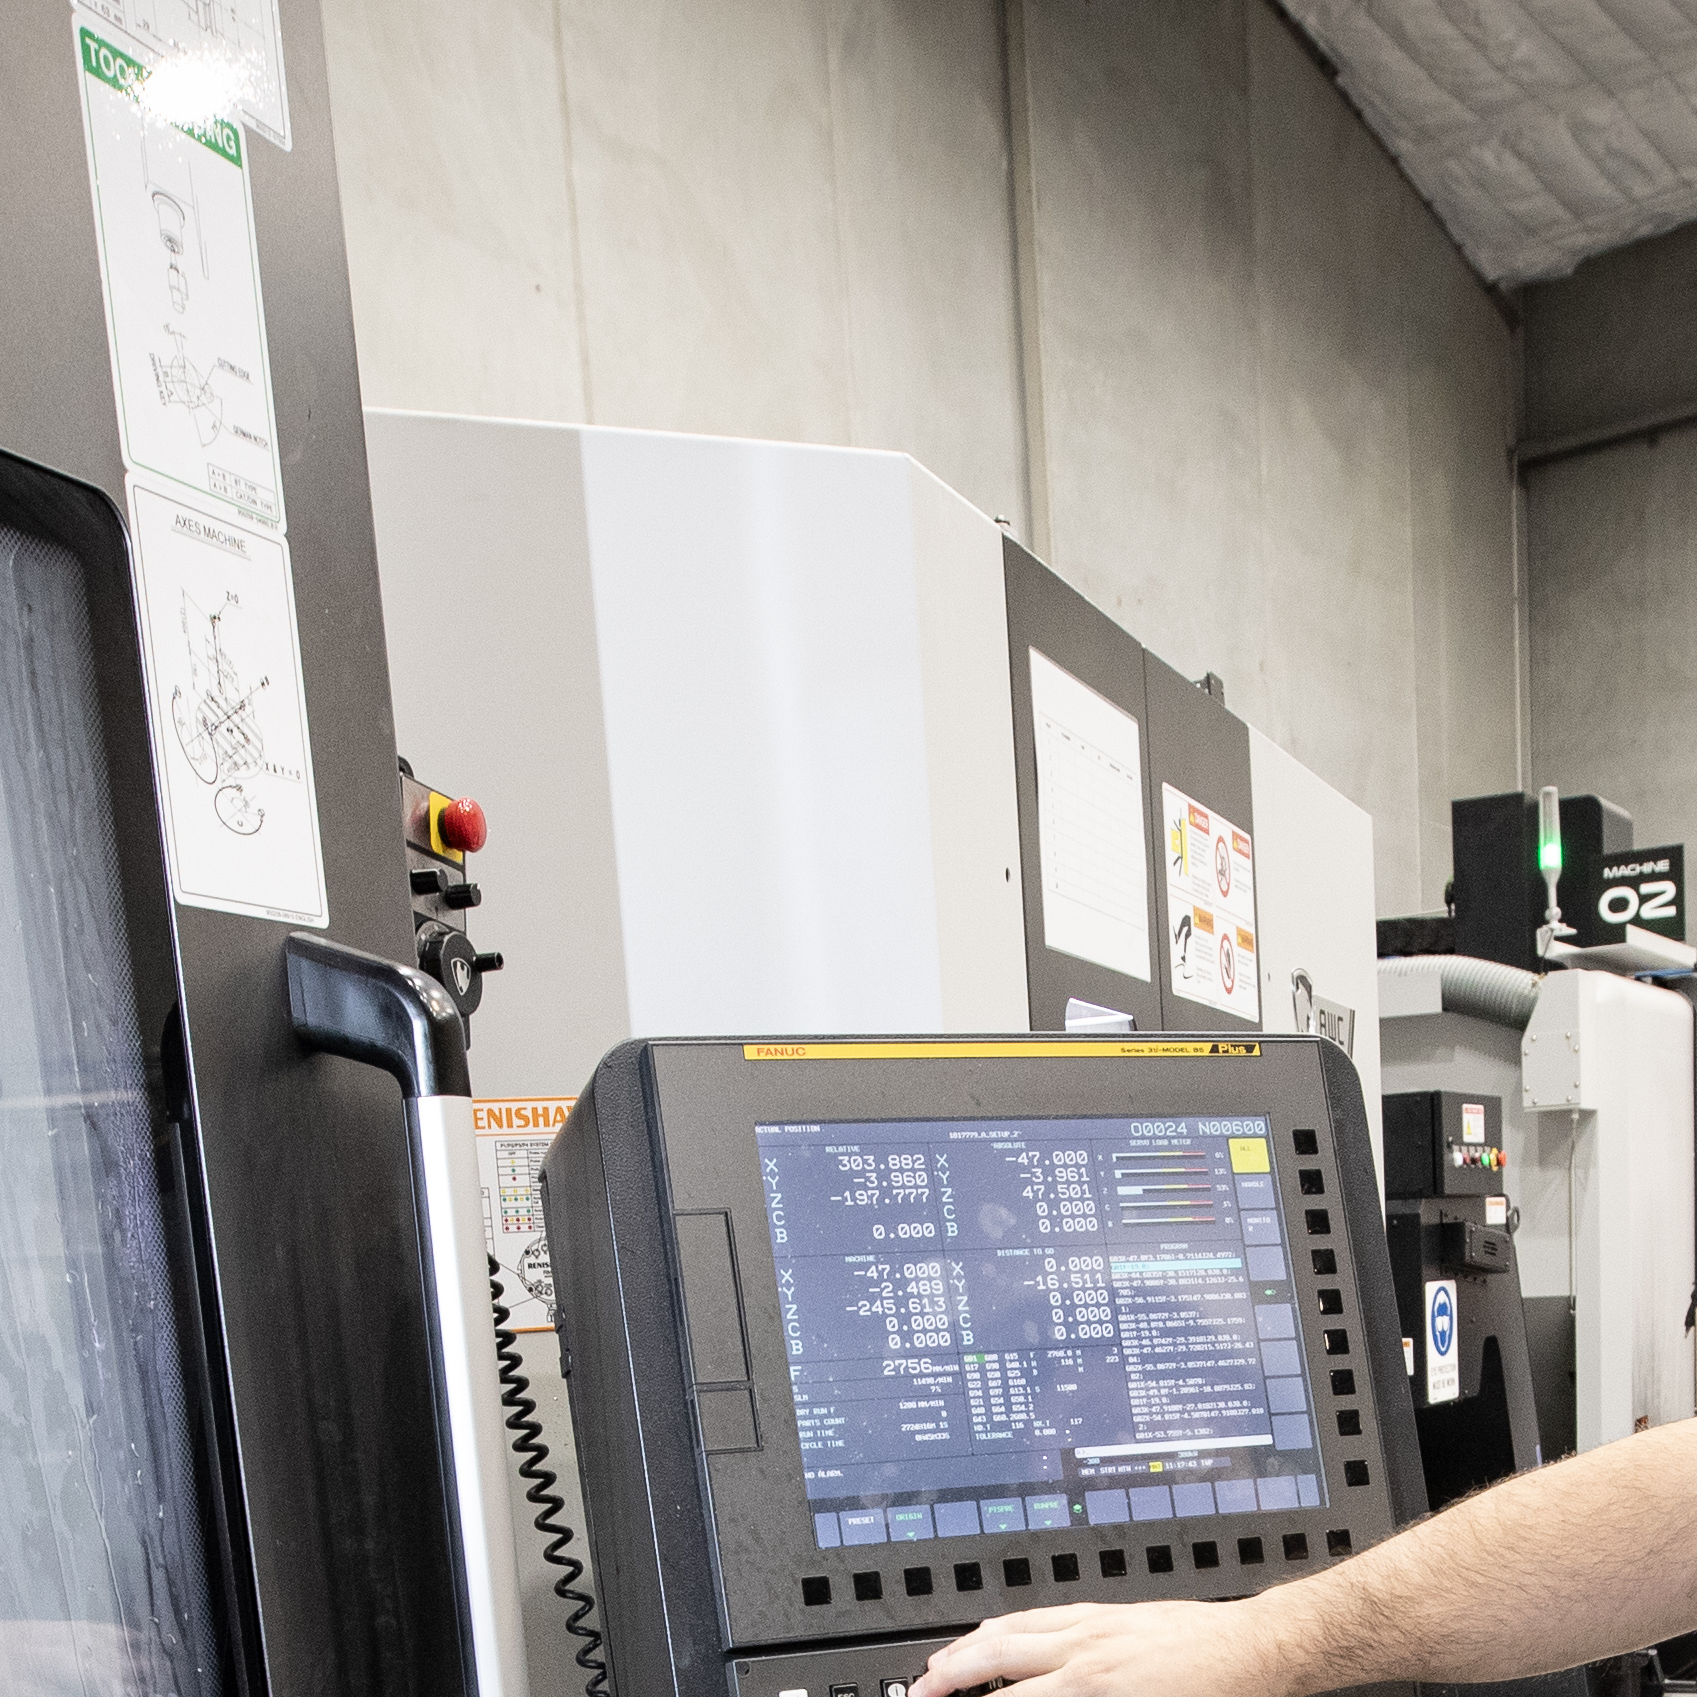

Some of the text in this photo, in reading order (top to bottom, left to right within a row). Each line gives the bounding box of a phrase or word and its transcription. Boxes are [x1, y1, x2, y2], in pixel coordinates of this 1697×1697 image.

[175, 514, 246, 553] AXES MACHINE
[1603, 859, 1670, 879] MACHINE
[1598, 880, 1676, 924] 02
[756, 1047, 806, 1057] FANUC
[1218, 1043, 1247, 1055] Plus
[472, 1106, 574, 1130] ENISHA
[785, 1125, 820, 1133] POSITION
[1198, 1120, 1266, 1135] N00600
[825, 1145, 860, 1153] RELATIVE
[765, 1155, 925, 1172] X 303.882
[936, 1151, 1088, 1168] X -47.000
[767, 1172, 927, 1190] Y -3.960
[938, 1168, 1090, 1185] Y -3.961
[769, 1189, 929, 1208] Z -197.777
[941, 1185, 1092, 1202] Z 47.501
[773, 1211, 785, 1225] C
[943, 1201, 1095, 1219] C 0.000
[775, 1223, 935, 1243] B 0.000
[946, 1218, 1098, 1237] B 0.000
[997, 1248, 1030, 1256] DISTANCE
[1160, 1242, 1188, 1250] PROGRAM
[845, 1255, 876, 1263] MACHINE
[951, 1256, 1103, 1276] X 0.000
[780, 1263, 940, 1283] X -47.000
[783, 1280, 943, 1301] Y -2.489
[954, 1273, 1105, 1293] Y -16.511
[785, 1297, 946, 1319] Z -245.613
[956, 1290, 1108, 1310] Z 0.000
[788, 1314, 948, 1337] C 0.000
[959, 1307, 1111, 1327] C 0.000
[962, 1324, 1113, 1345] B 0.000
[790, 1332, 950, 1355] B 0.000
[790, 1366, 801, 1381] F
[797, 1408, 810, 1416] DRY
[797, 1417, 845, 1427] PARTS COUNT
[801, 1440, 845, 1450] CYCLE TIME
[805, 1471, 814, 1479] NO
[848, 1516, 874, 1525] PRESET
[896, 1513, 922, 1521] ORIGIN
